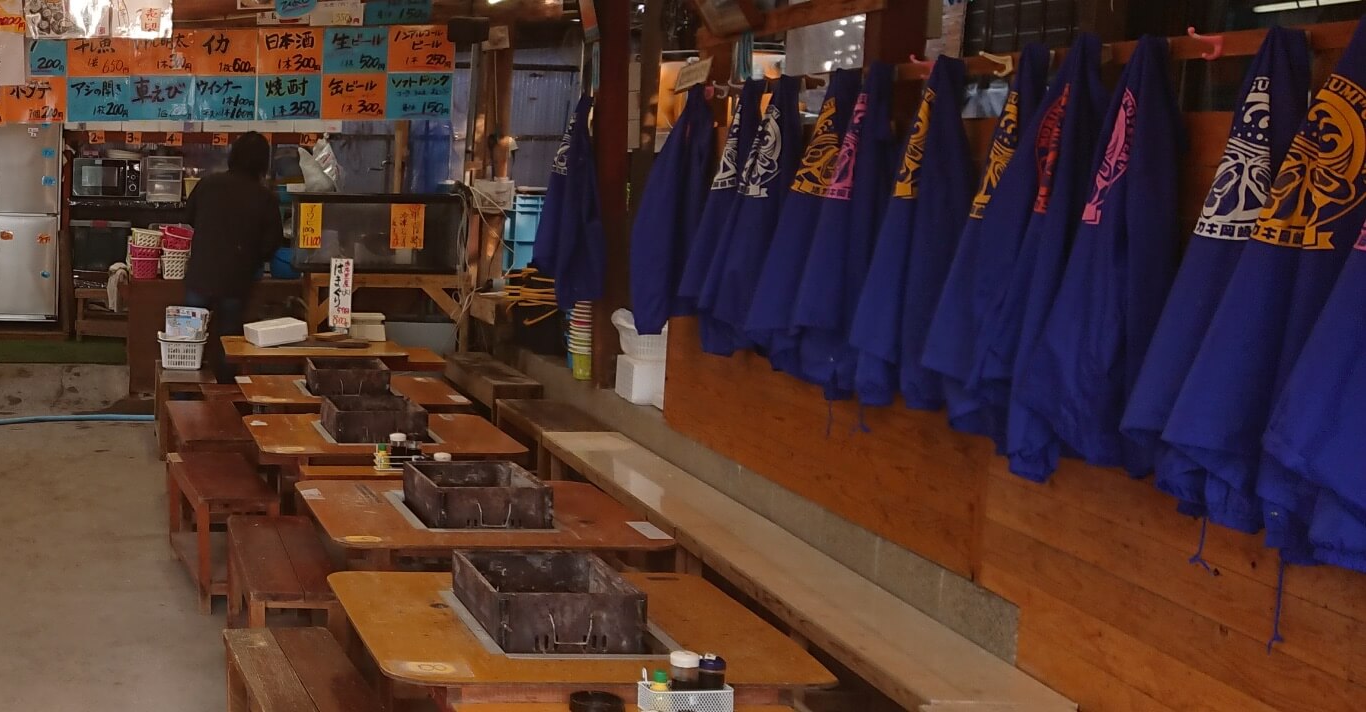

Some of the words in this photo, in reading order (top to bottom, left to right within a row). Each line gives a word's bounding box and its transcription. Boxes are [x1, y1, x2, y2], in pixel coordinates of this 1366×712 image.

[203, 34, 229, 54] イカ
[265, 31, 315, 50] 日本酒
[332, 32, 384, 50] 生ビール
[394, 30, 443, 42] ノンアルコール
[412, 41, 442, 51] ビール
[71, 80, 122, 97] アジの開き
[132, 77, 186, 103] 車えび
[196, 80, 243, 95] ウインナー
[266, 77, 308, 97] 焼酎
[329, 77, 377, 97] 缶ビール
[392, 76, 450, 89] ソフトドリンク
